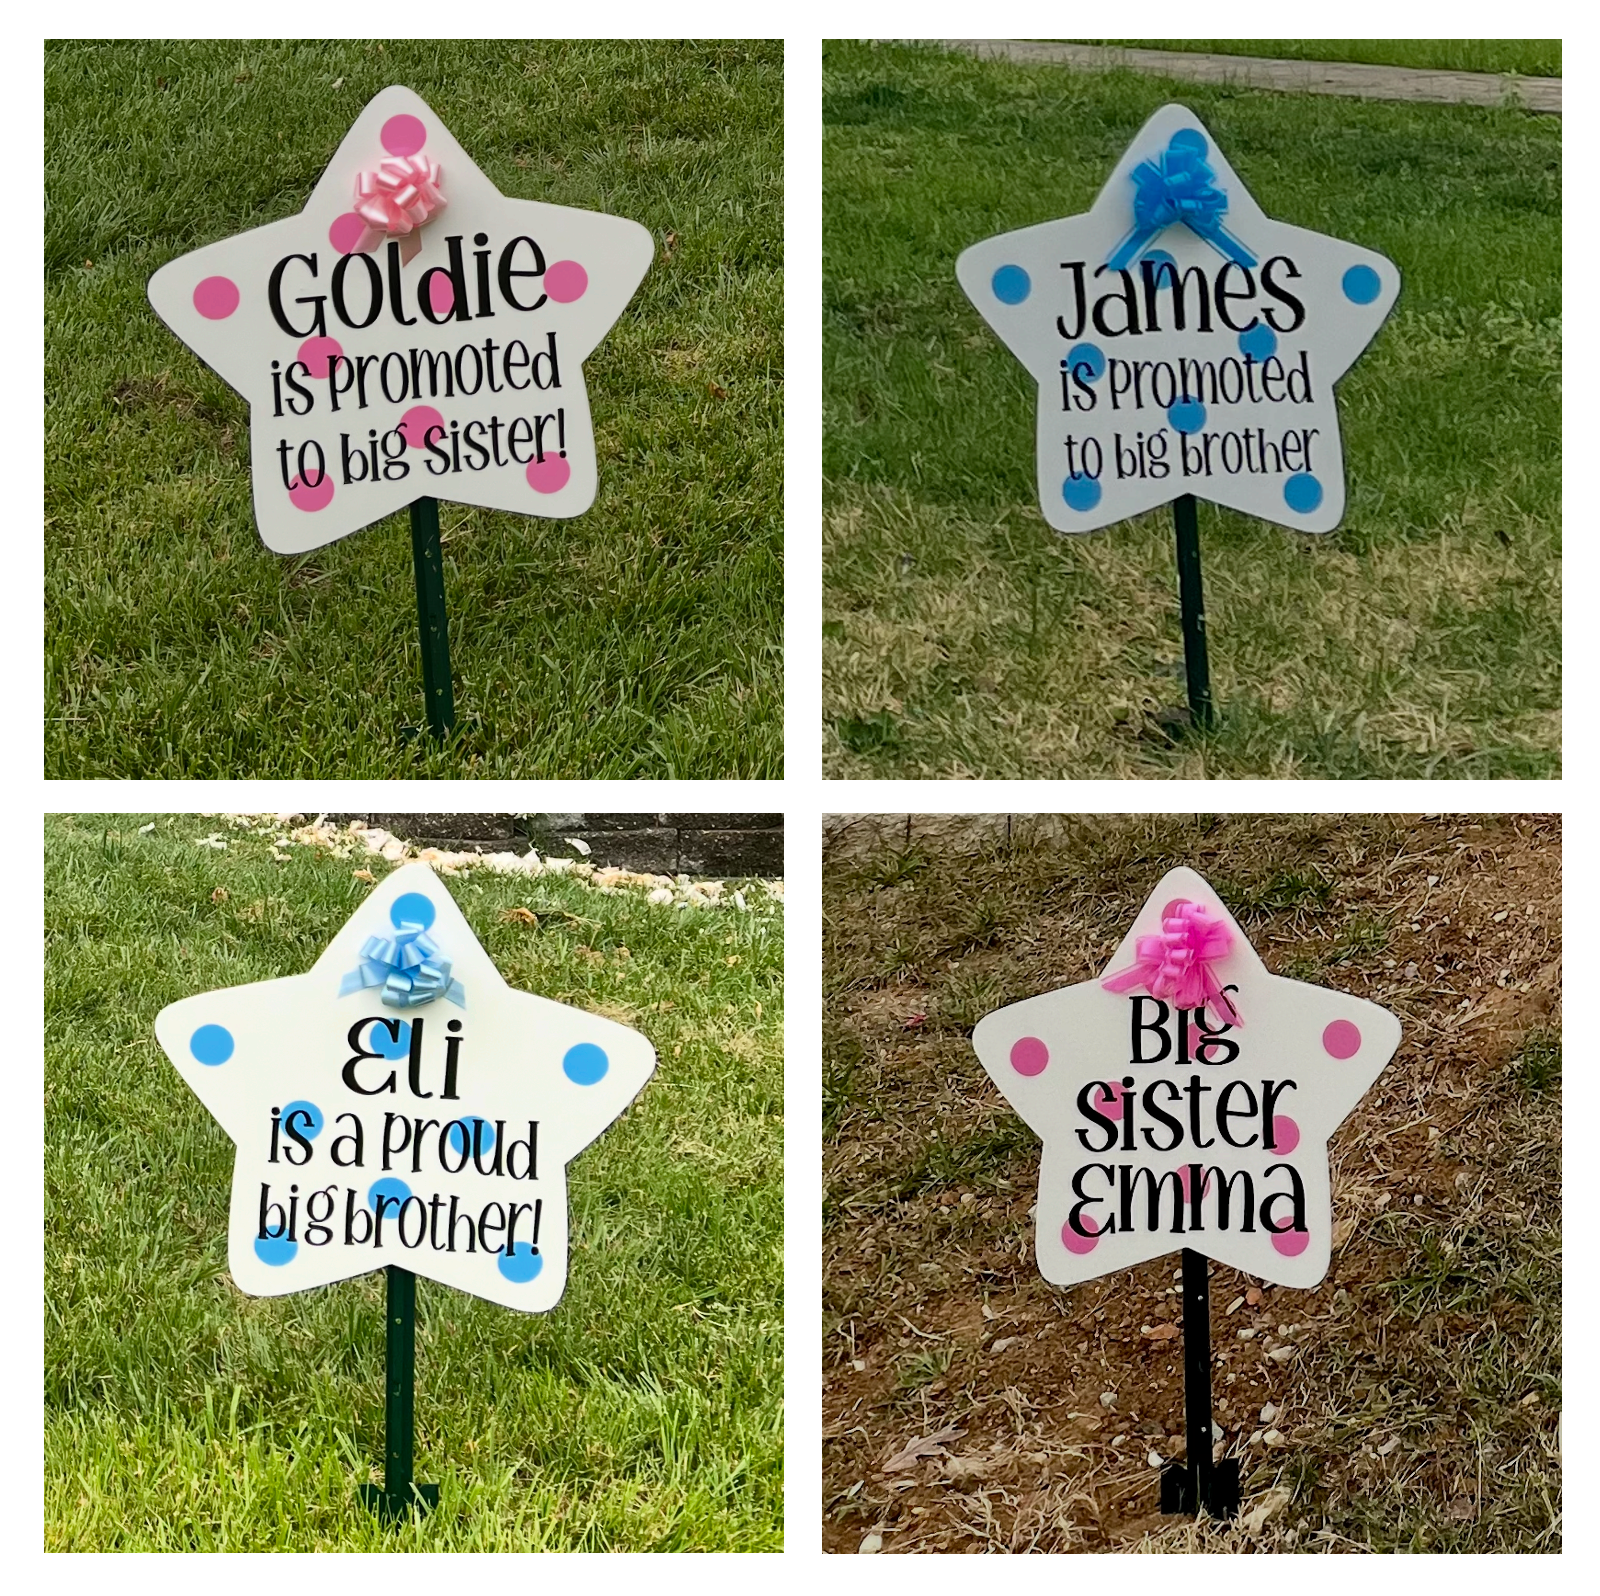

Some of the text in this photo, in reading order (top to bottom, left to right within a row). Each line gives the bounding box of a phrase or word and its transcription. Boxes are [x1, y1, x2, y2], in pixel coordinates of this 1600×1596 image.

[268, 232, 548, 338] Goldie
[1056, 256, 1306, 340] James
[270, 331, 562, 417] is promoted
[1060, 350, 1314, 412] is promoted
[276, 408, 567, 490] to big sister!
[1064, 428, 1320, 481] to big brother
[341, 1016, 464, 1100] Eli
[1129, 984, 1240, 1065] Big
[268, 1106, 540, 1180] is a proud
[1075, 1075, 1297, 1152] sister
[258, 1182, 543, 1257] big brother!
[1068, 1163, 1308, 1238] Emma
